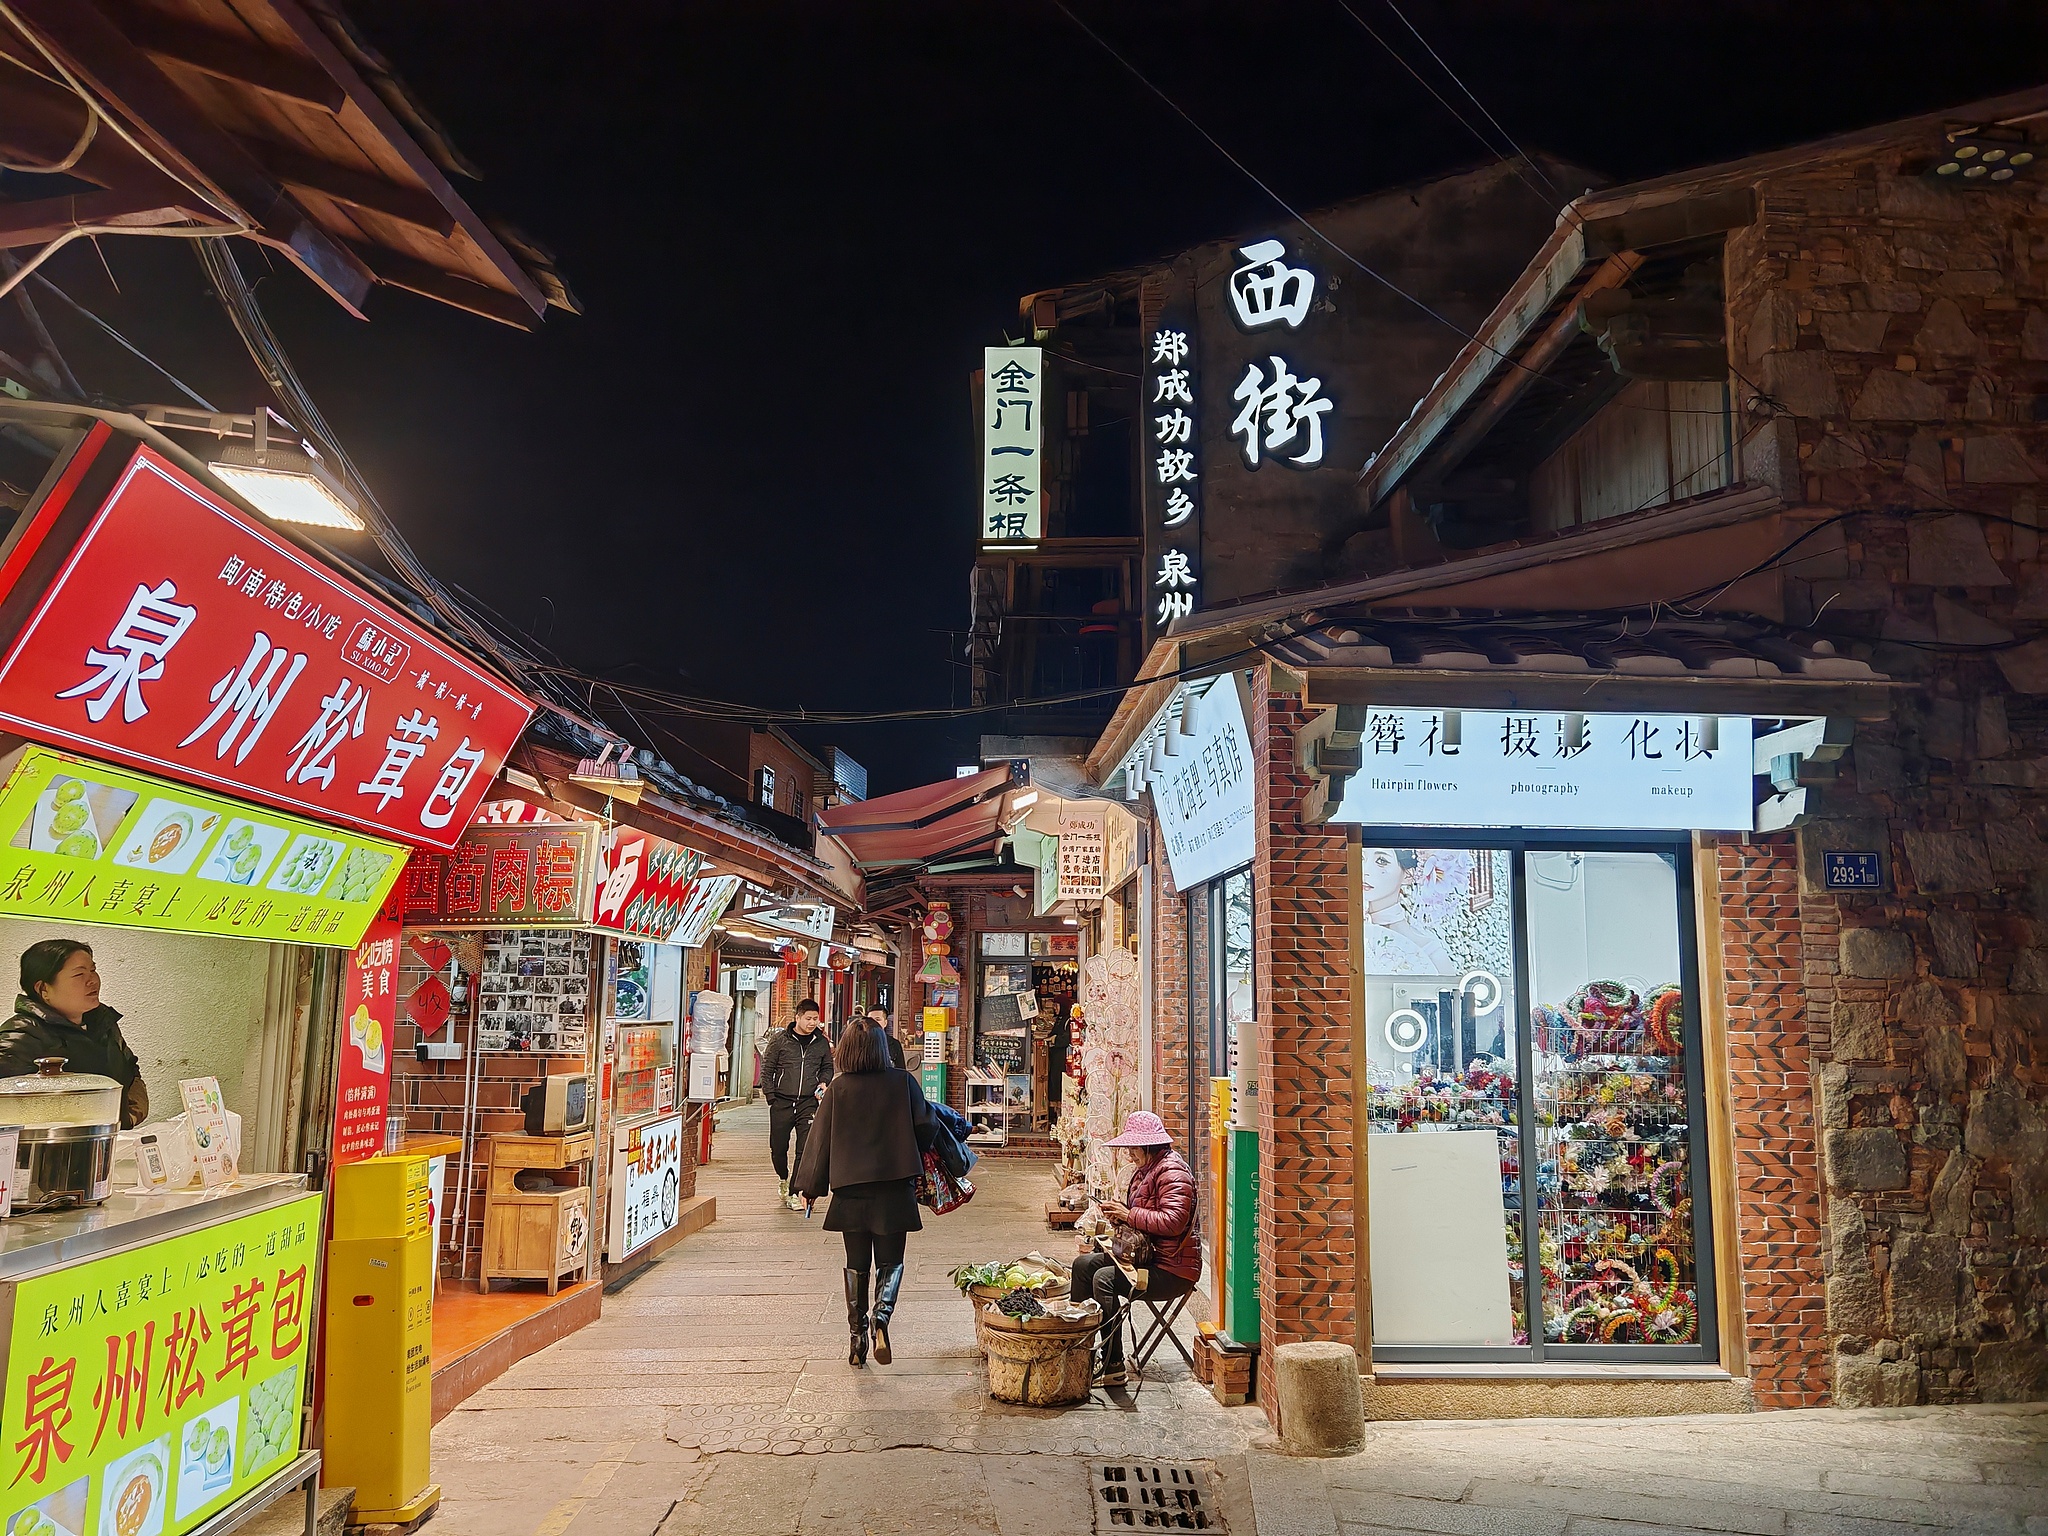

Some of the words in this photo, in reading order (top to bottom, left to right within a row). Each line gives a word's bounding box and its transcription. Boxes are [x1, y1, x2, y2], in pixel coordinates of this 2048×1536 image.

[1230, 239, 1334, 465] 西街
[988, 359, 1036, 539] 金门一条根
[1152, 330, 1199, 527] 郑成功故乡
[1155, 548, 1198, 625] 泉州
[350, 649, 361, 661] SU
[361, 655, 381, 673] XIAO
[380, 666, 390, 677] JI
[354, 626, 403, 668] 蘇小記
[55, 578, 486, 831] 泉州松茸包
[1367, 713, 1462, 758] 簪花
[1500, 716, 1592, 760] 摄影
[1620, 718, 1714, 762] 化妆
[1371, 777, 1416, 792] Hairpin
[1416, 778, 1459, 792] flowers
[1510, 780, 1581, 796] photography
[1650, 783, 1694, 798] makeup
[403, 839, 577, 914] 西街肉粽
[1832, 866, 1867, 884] 293-1
[1836, 855, 1869, 866] 西街
[361, 967, 391, 1001] 美食
[6, 1263, 308, 1491] 泉州松茸包
